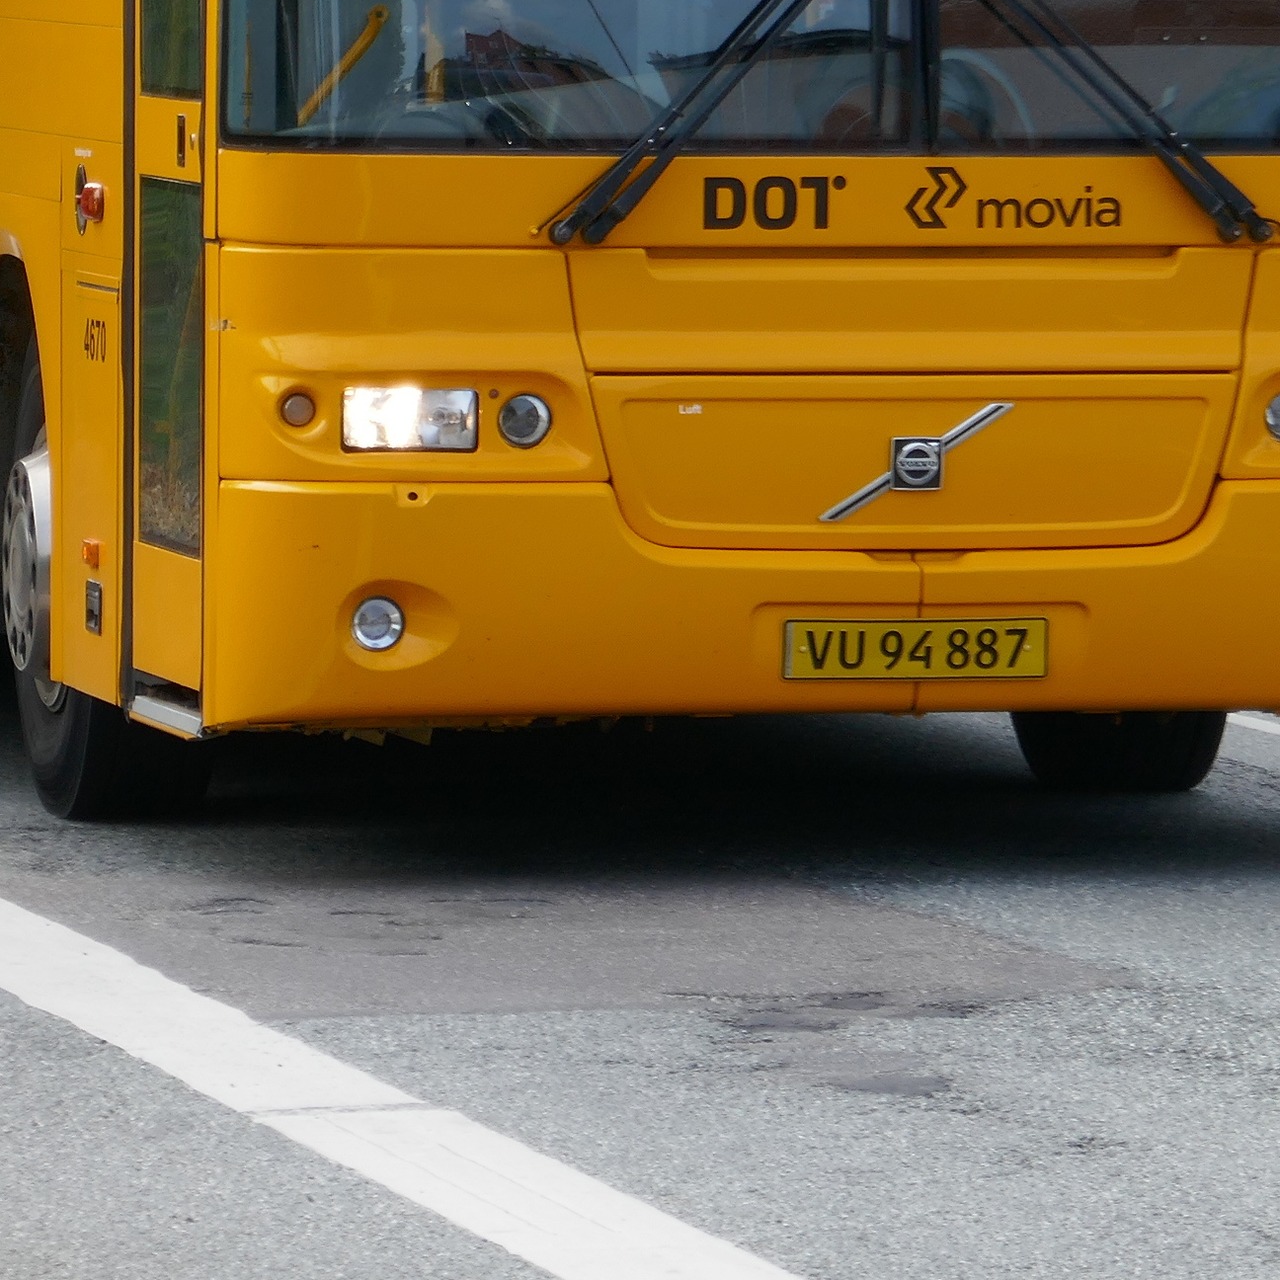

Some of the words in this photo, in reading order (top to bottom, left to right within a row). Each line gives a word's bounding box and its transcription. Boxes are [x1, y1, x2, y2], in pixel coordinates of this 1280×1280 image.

[703, 175, 830, 230] DOT
[975, 185, 1121, 229] movia
[83, 318, 107, 363] 4670
[805, 629, 867, 671] VU
[878, 629, 934, 671] 94
[945, 627, 1029, 671] 887
